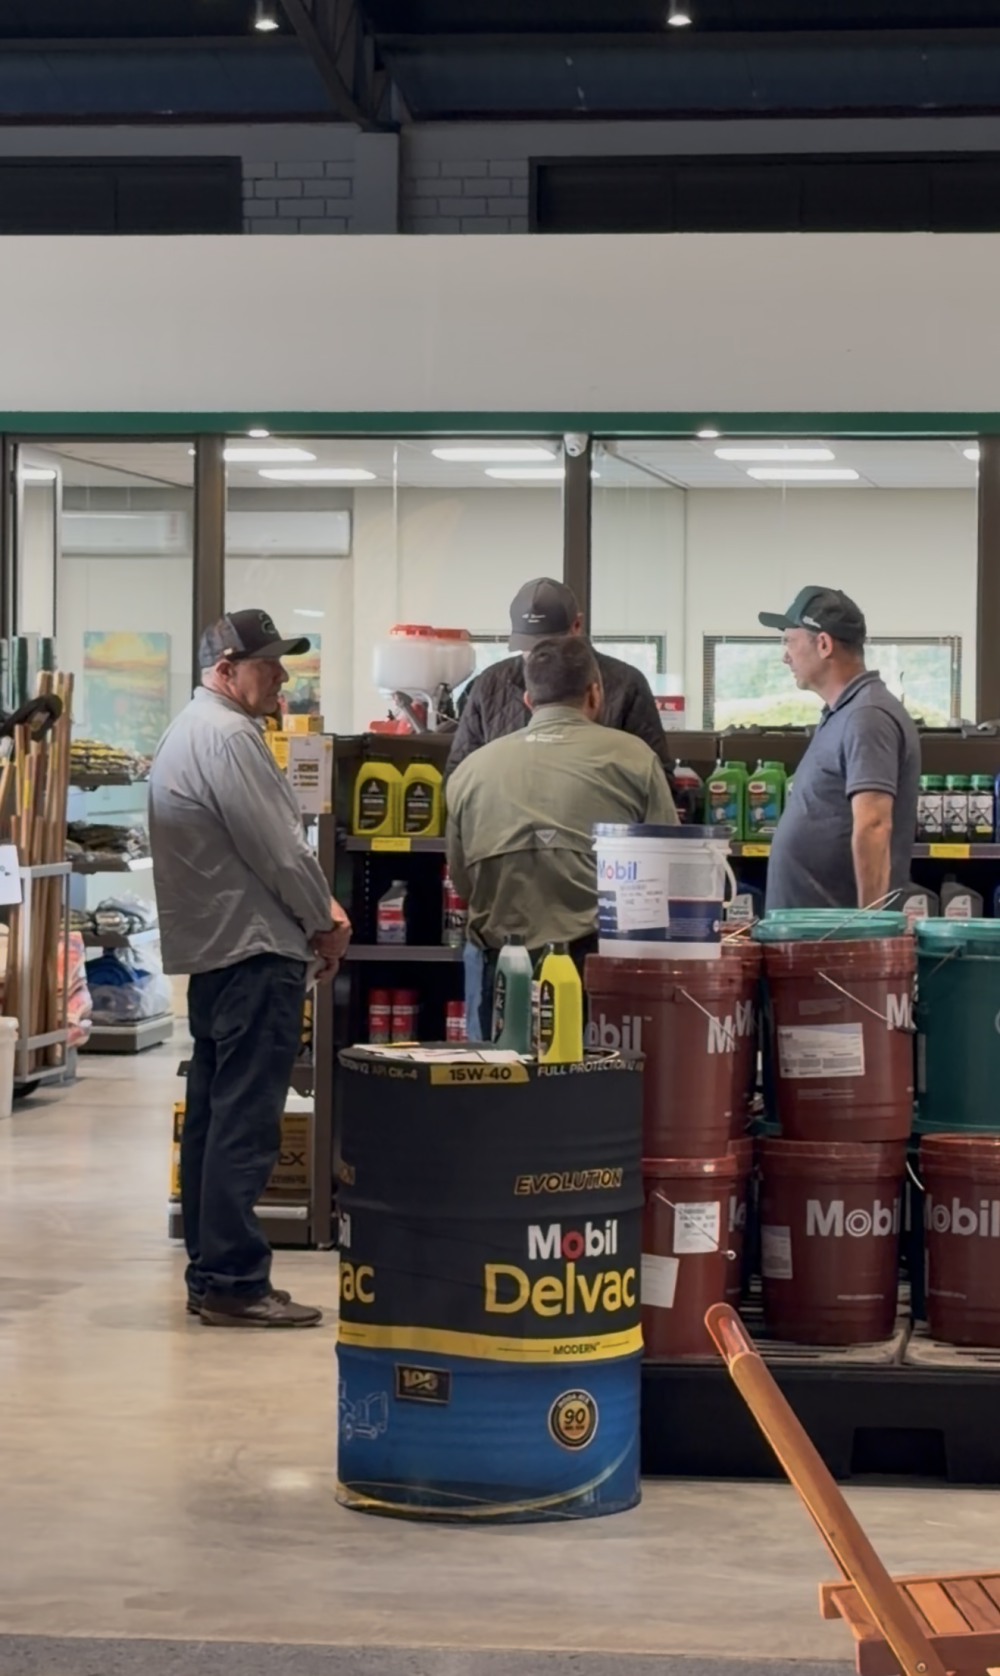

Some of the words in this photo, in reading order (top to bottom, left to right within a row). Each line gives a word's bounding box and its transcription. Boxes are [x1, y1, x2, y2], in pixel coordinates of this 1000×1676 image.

[449, 1067, 512, 1082] 15W-40
[537, 1065, 567, 1077] FULL
[514, 1167, 623, 1195] EVOLUTION
[527, 1219, 618, 1261] Mobil
[484, 1262, 635, 1317] Delvac
[553, 1343, 597, 1356] MODERN
[564, 1407, 587, 1425] 90
